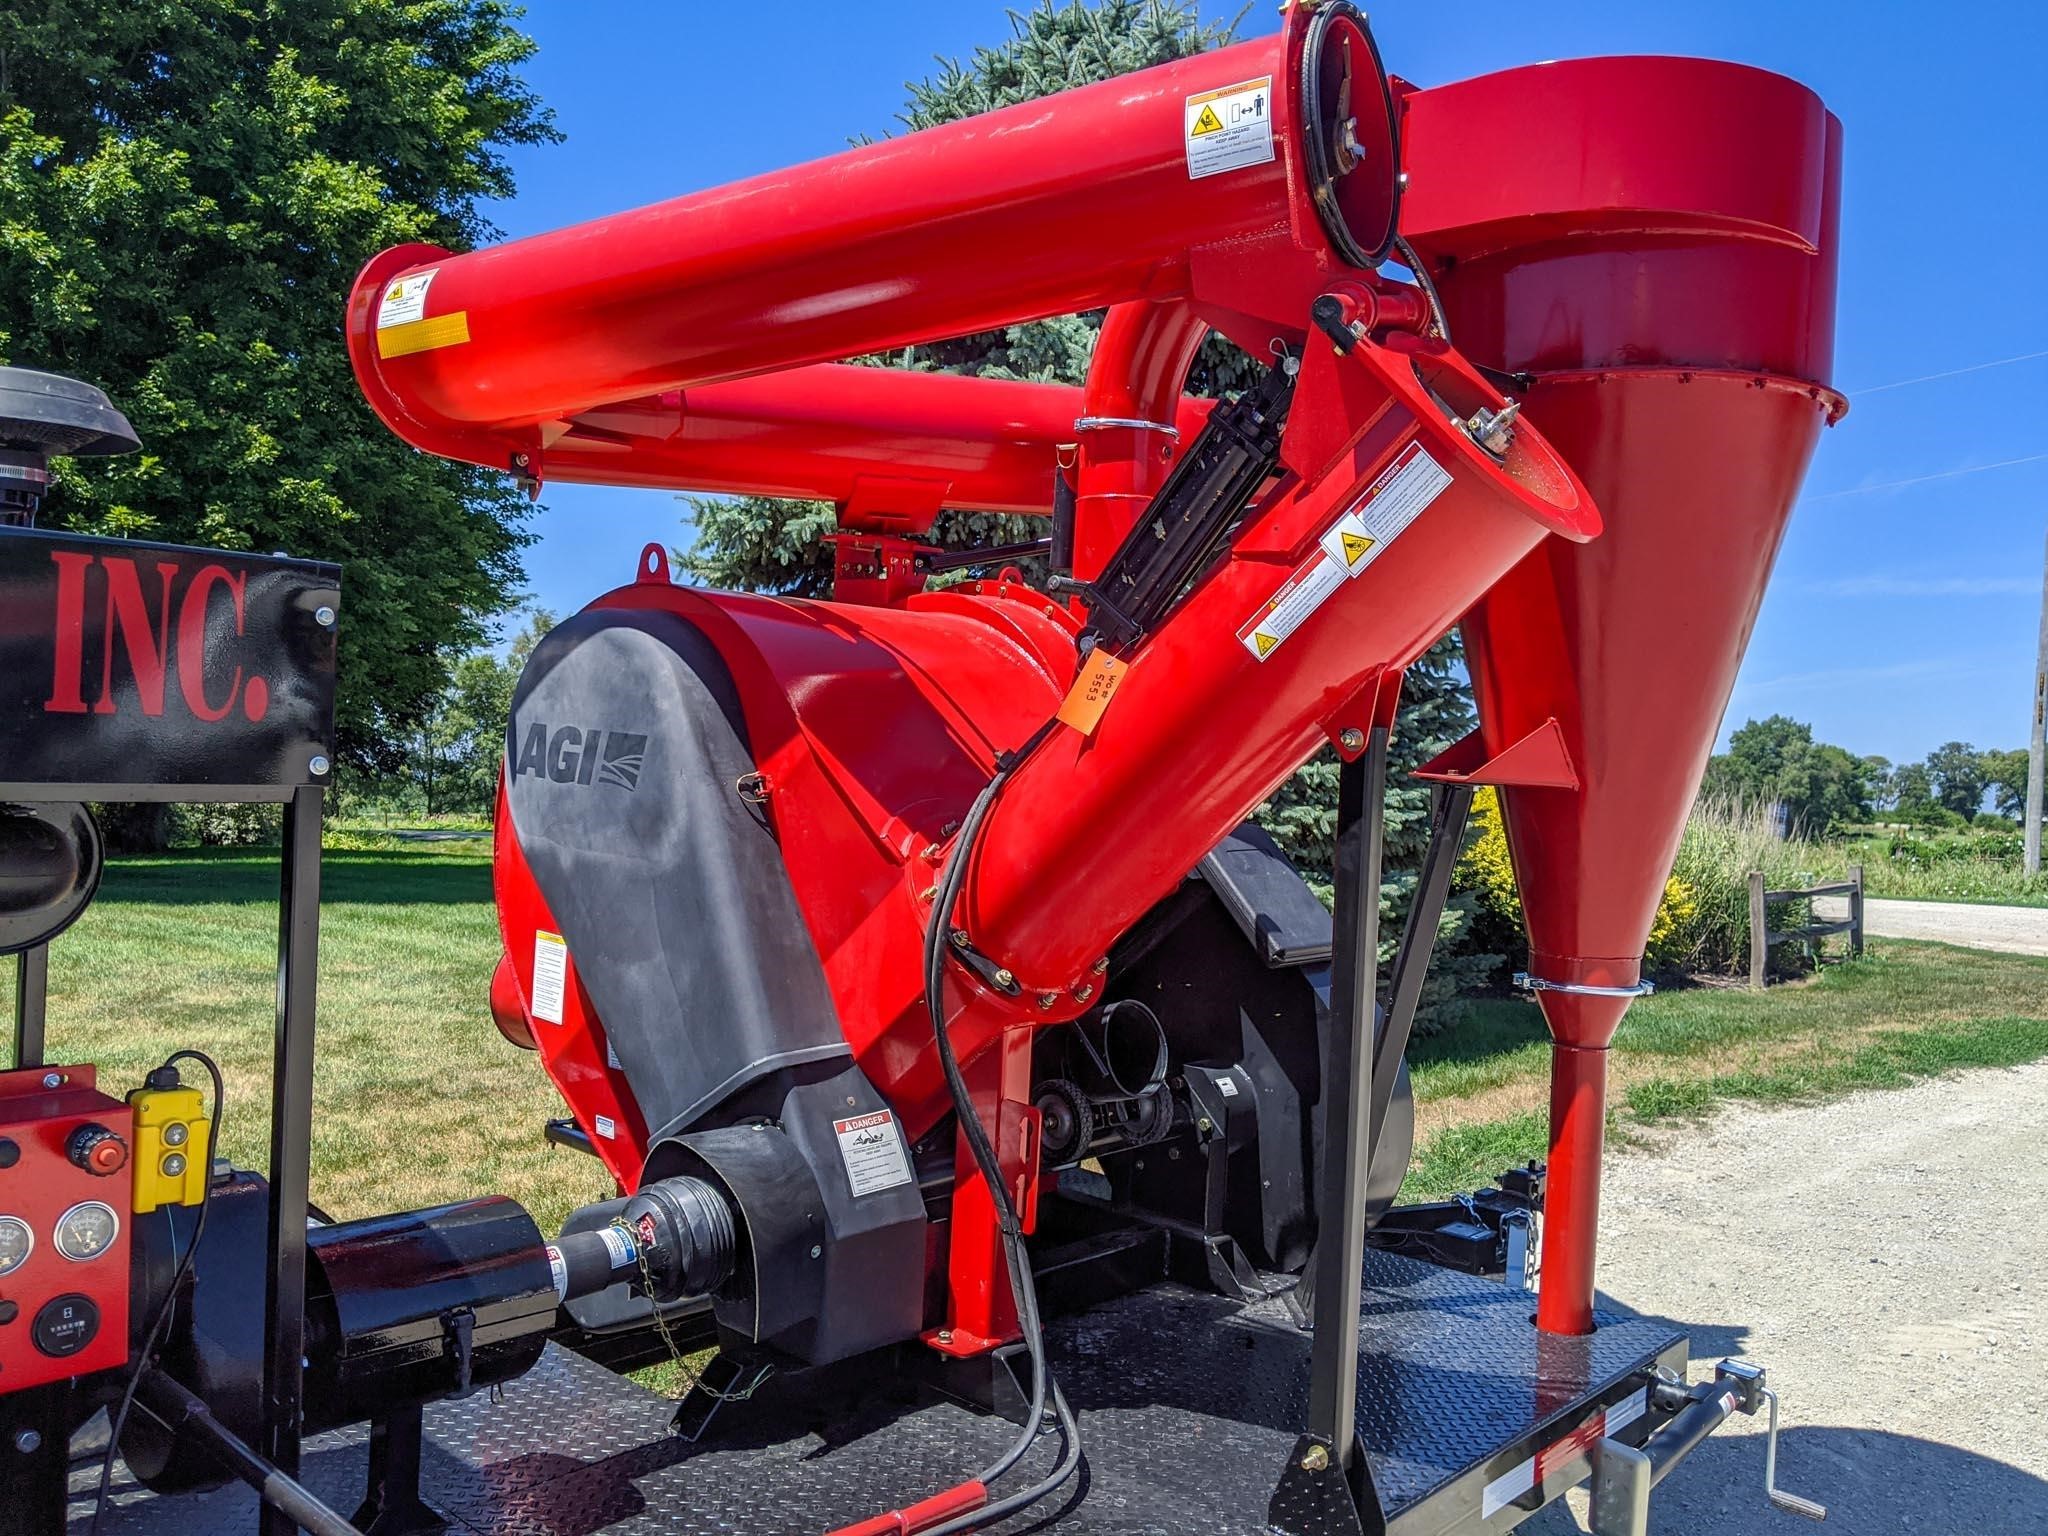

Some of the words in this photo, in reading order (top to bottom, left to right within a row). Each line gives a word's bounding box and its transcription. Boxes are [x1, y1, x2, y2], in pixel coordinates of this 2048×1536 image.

[1377, 463, 1402, 489] DANGER
[1274, 581, 1297, 604] DANGER
[44, 550, 268, 722] INC.
[1086, 673, 1105, 701] 5553
[516, 722, 601, 785] AGI
[852, 1115, 885, 1129] DANGER
[77, 1132, 93, 1147] LOCK
[618, 1230, 633, 1250] NOTICE
